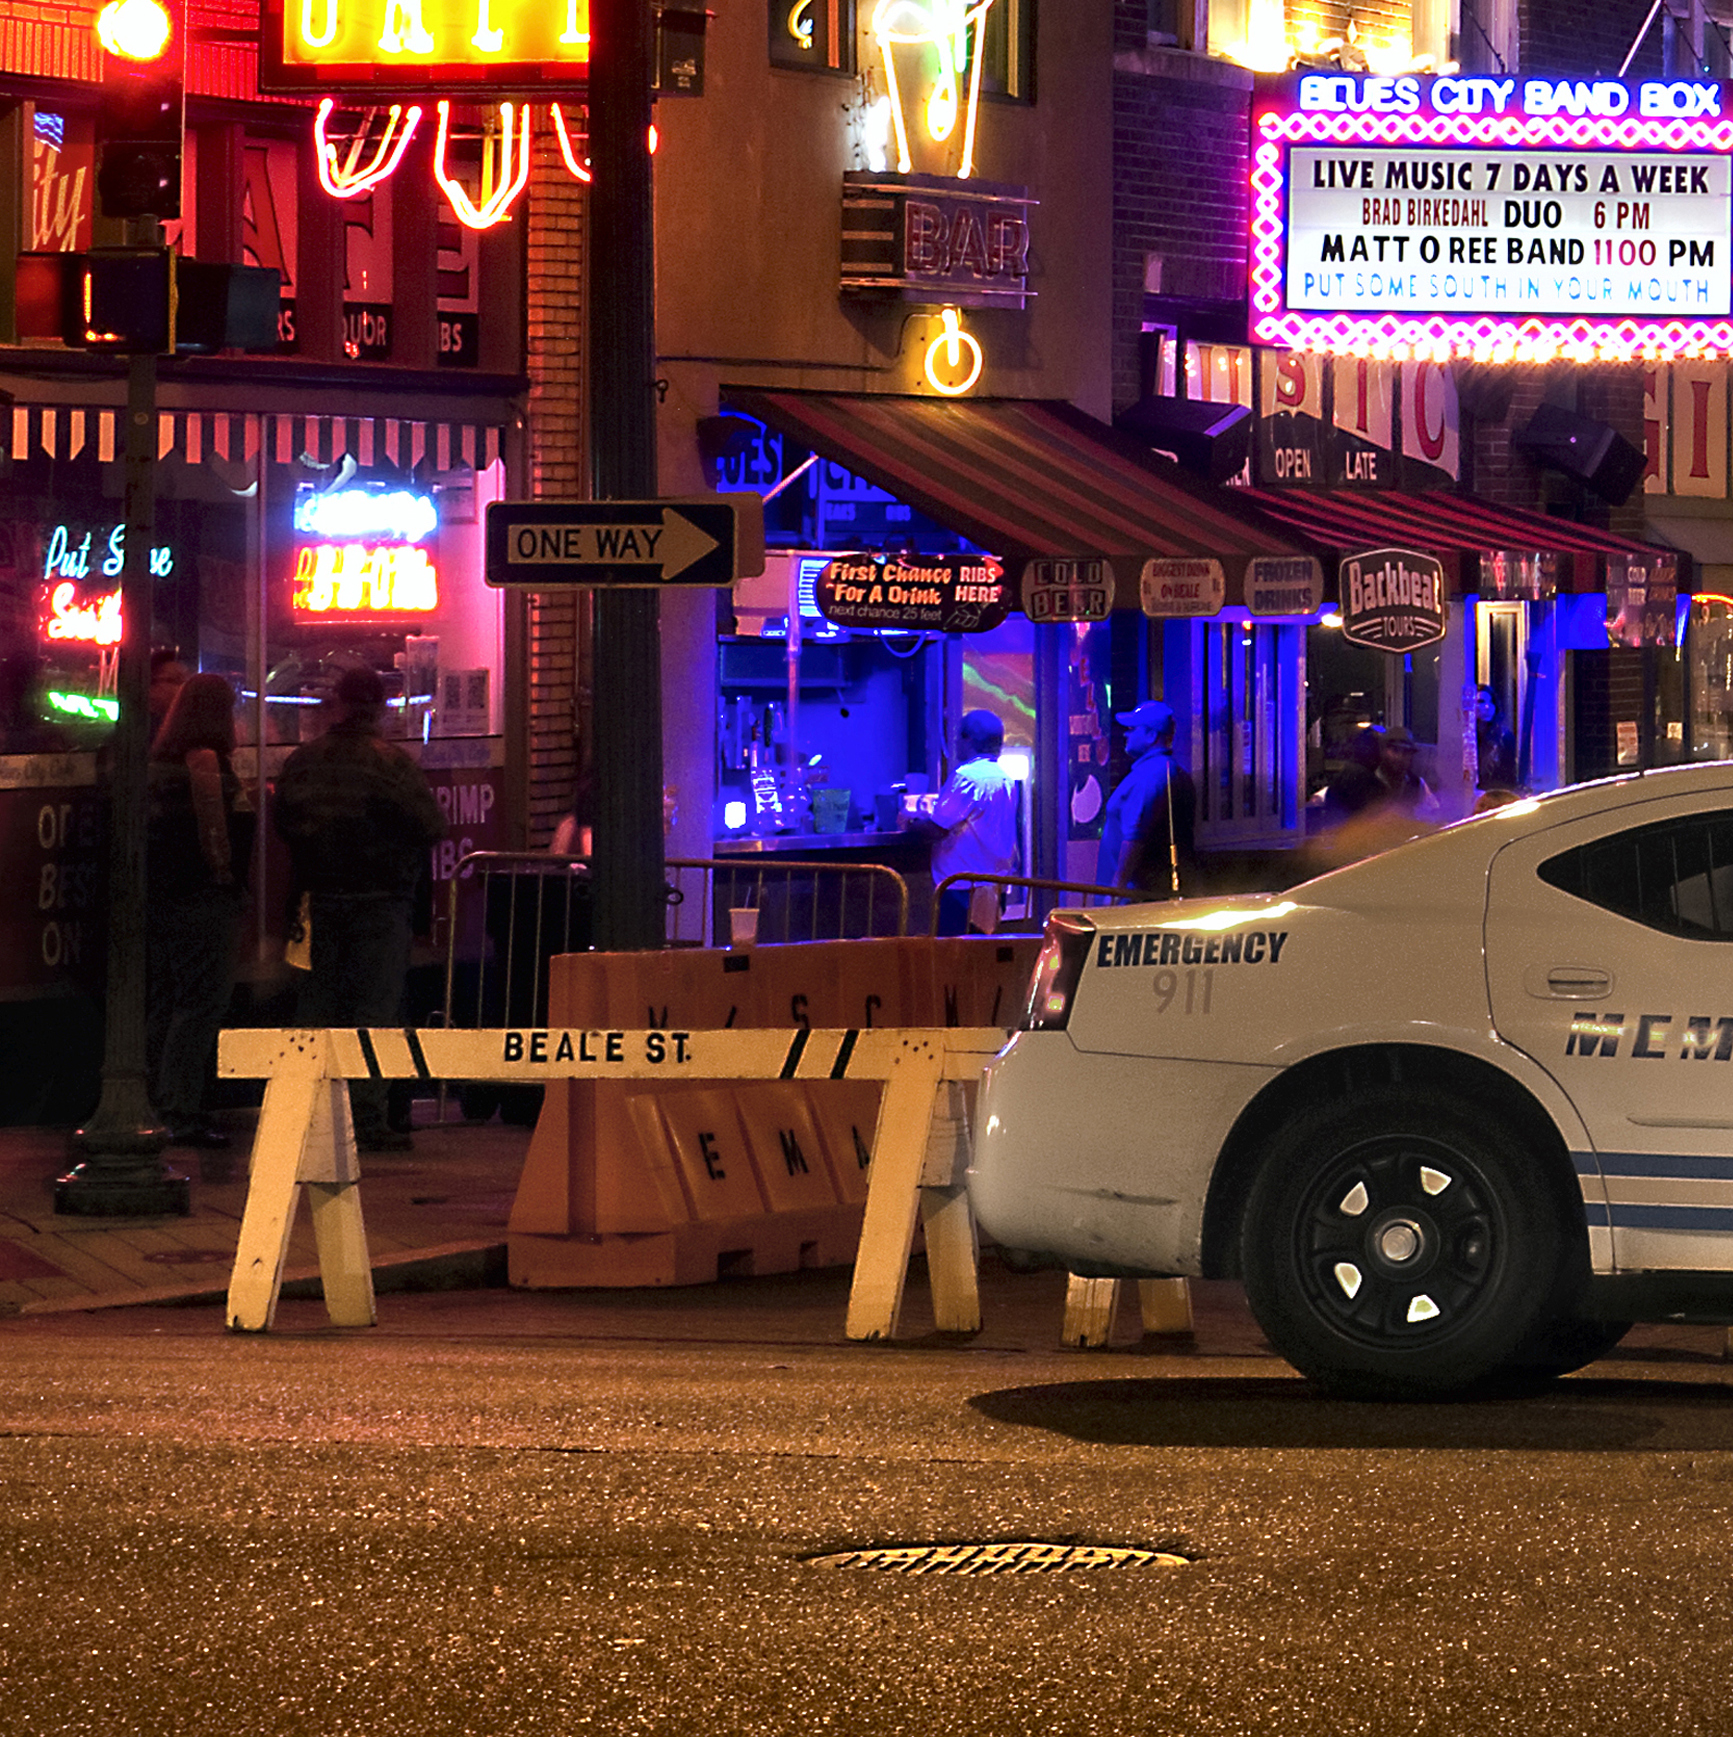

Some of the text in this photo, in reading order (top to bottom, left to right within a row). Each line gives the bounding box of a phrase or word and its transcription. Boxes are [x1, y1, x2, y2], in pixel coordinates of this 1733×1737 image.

[1299, 75, 1722, 119] BLUES CITY BAND BOX
[1313, 159, 1711, 195] LIVE MUSIC 7 DAYS A WEEK
[1362, 197, 1652, 231] BRAD BIRKEDAHL DUO 6 PM
[904, 200, 1030, 281] BAR
[1320, 234, 1411, 265] MATT
[1449, 236, 1498, 265] REE
[1507, 237, 1586, 266] BAND
[1593, 238, 1658, 266] 1100
[1669, 239, 1716, 268] PM
[1303, 272, 1711, 304] PUT SOME SOUTH IN YOUR MOUTH
[1275, 448, 1311, 479] OPEN
[1346, 451, 1377, 481] LATE
[44, 524, 92, 580] Put
[516, 528, 662, 560] ONE WAY
[829, 561, 952, 585] First Chance
[959, 565, 997, 584] RIBS
[1034, 562, 1105, 586] COLD
[1253, 561, 1314, 583] FROZEN
[1348, 560, 1443, 615] Backbeat
[834, 583, 943, 606] For A Drink
[954, 584, 1001, 603] HERE
[1031, 588, 1107, 620] BEER
[1253, 587, 1314, 612] DRINKS
[828, 604, 943, 622] next chance 25 feet
[1381, 616, 1415, 638] TOURS
[1096, 931, 1289, 968] EMERGENCY
[1152, 969, 1214, 1015] 911
[503, 1032, 693, 1064] BEALE ST.
